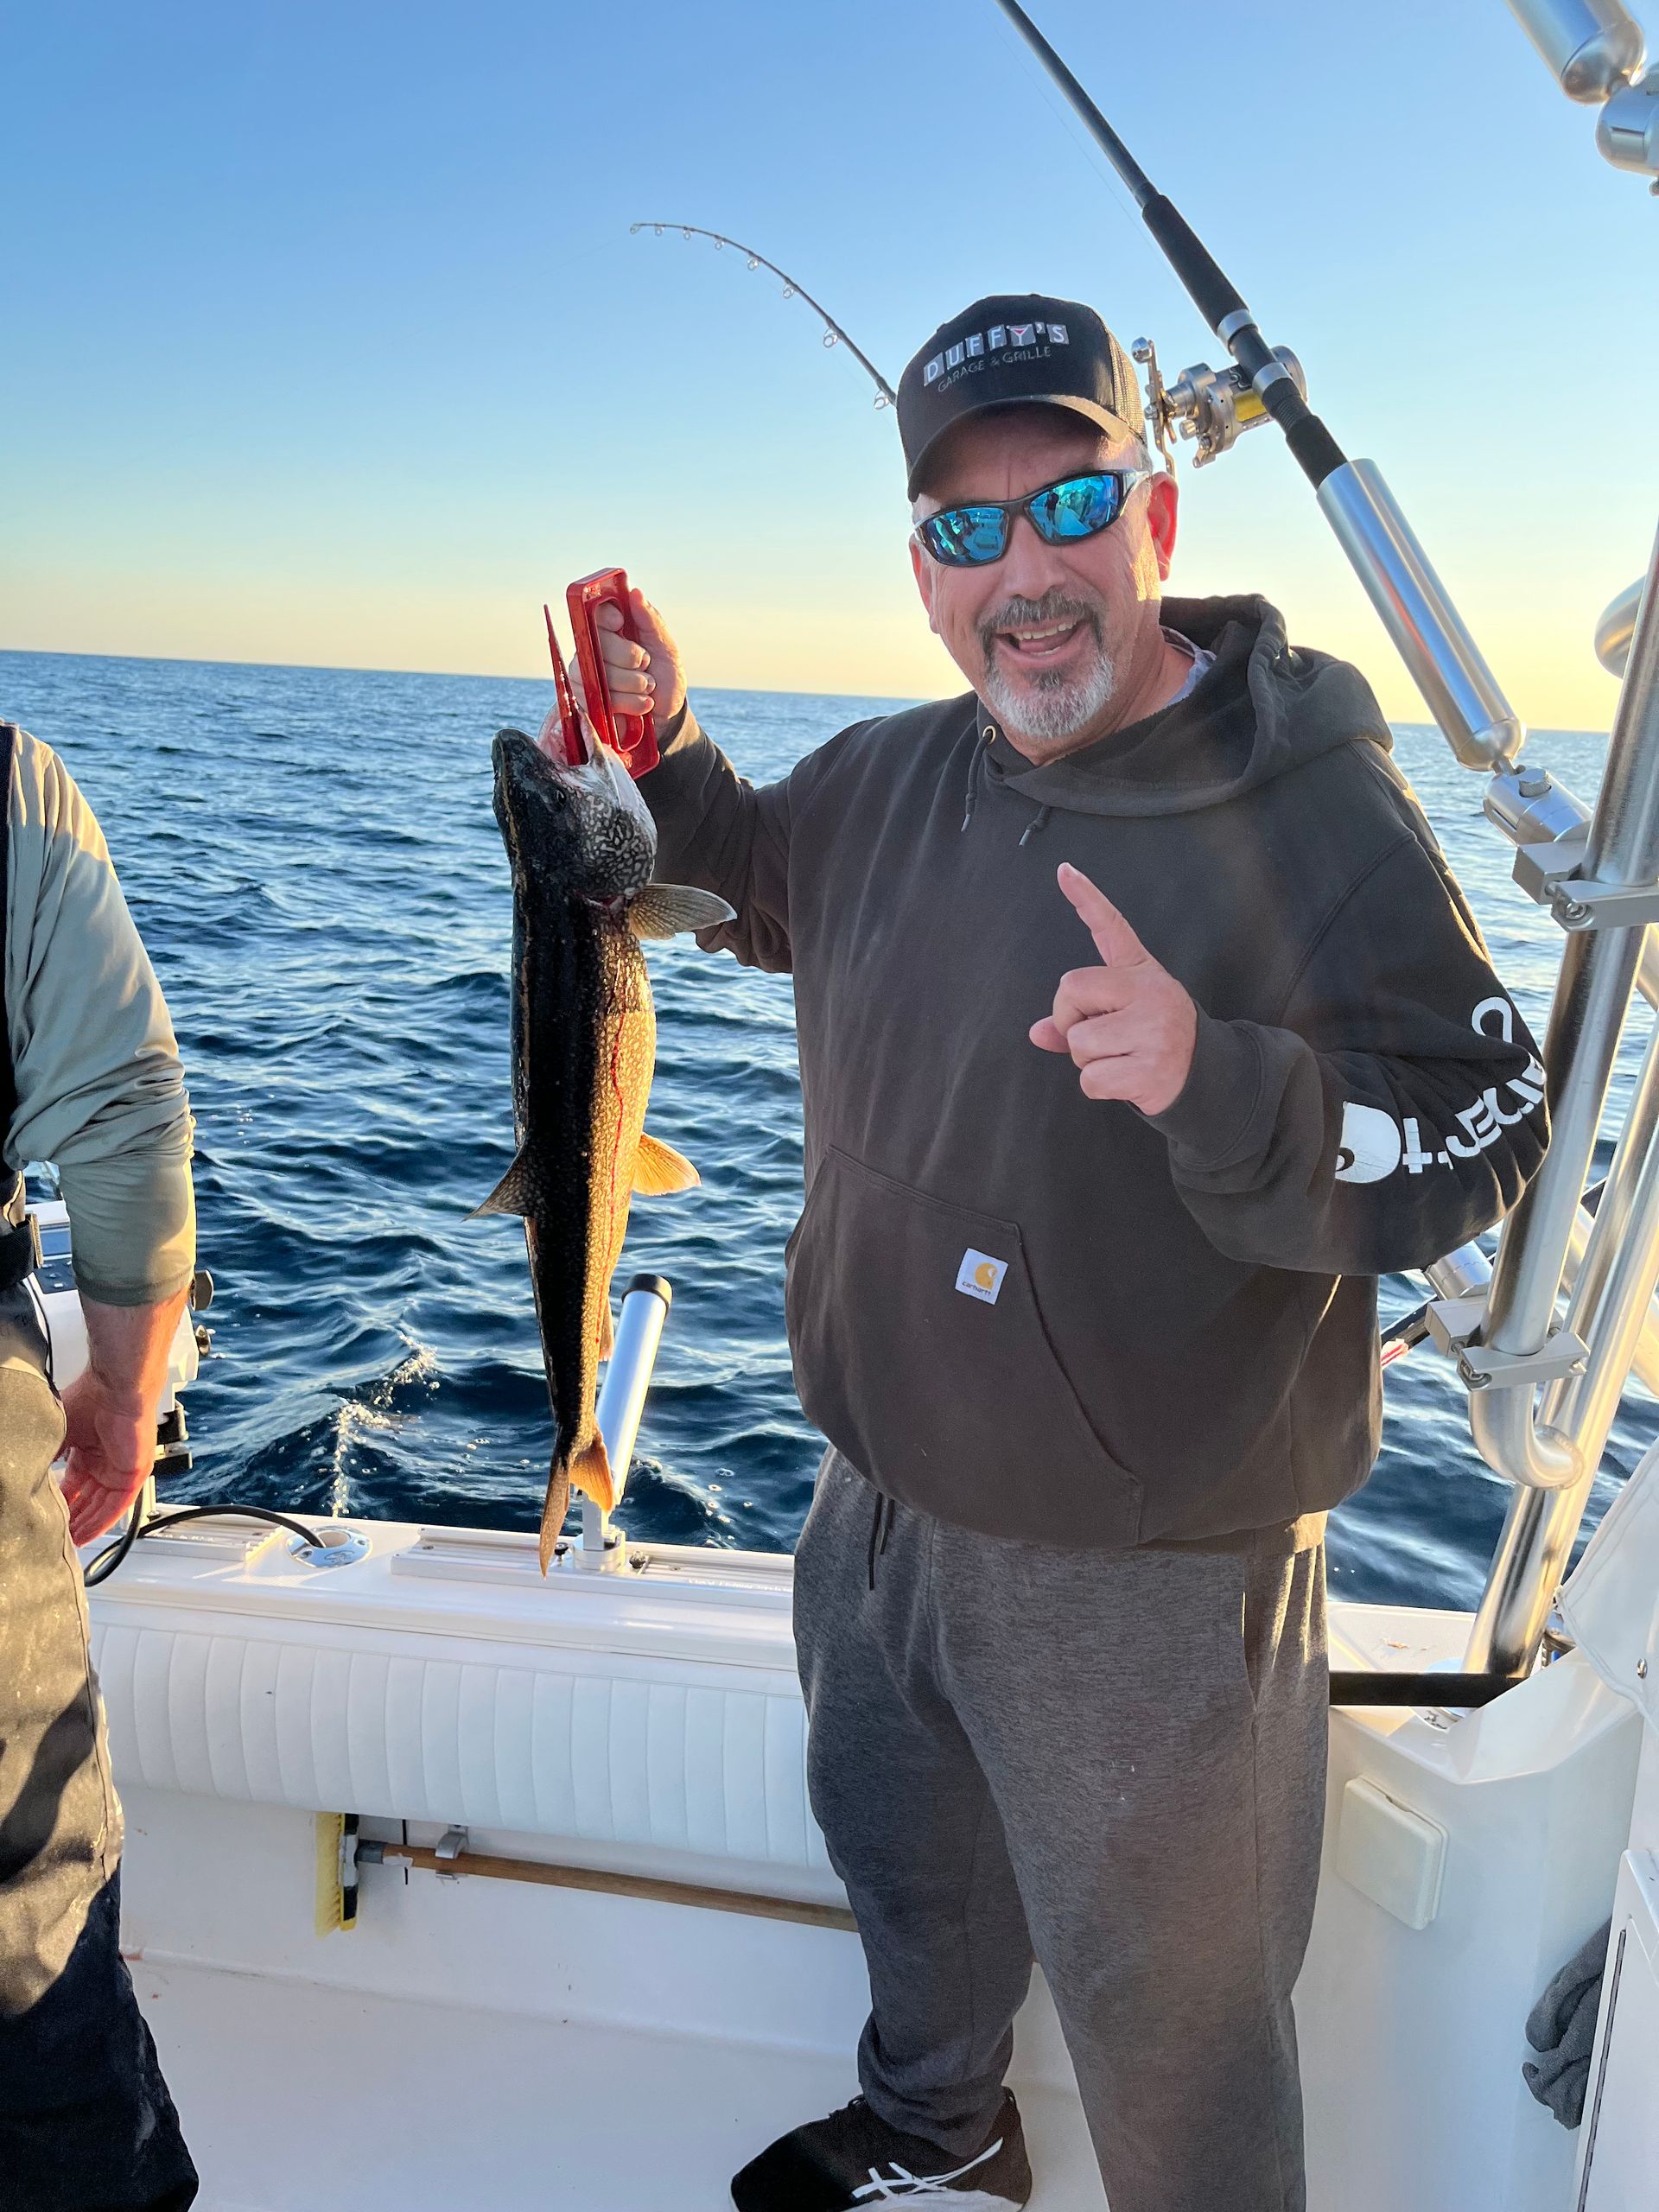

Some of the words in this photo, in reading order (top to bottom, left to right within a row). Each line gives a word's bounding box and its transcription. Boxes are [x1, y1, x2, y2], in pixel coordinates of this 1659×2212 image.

[924, 321, 1069, 385] DUFFY'S
[938, 360, 985, 392] GARAGE
[1002, 346, 1052, 364] GRILLE
[1402, 996, 1548, 1173] carat
[962, 1281, 991, 1296] carhartt
